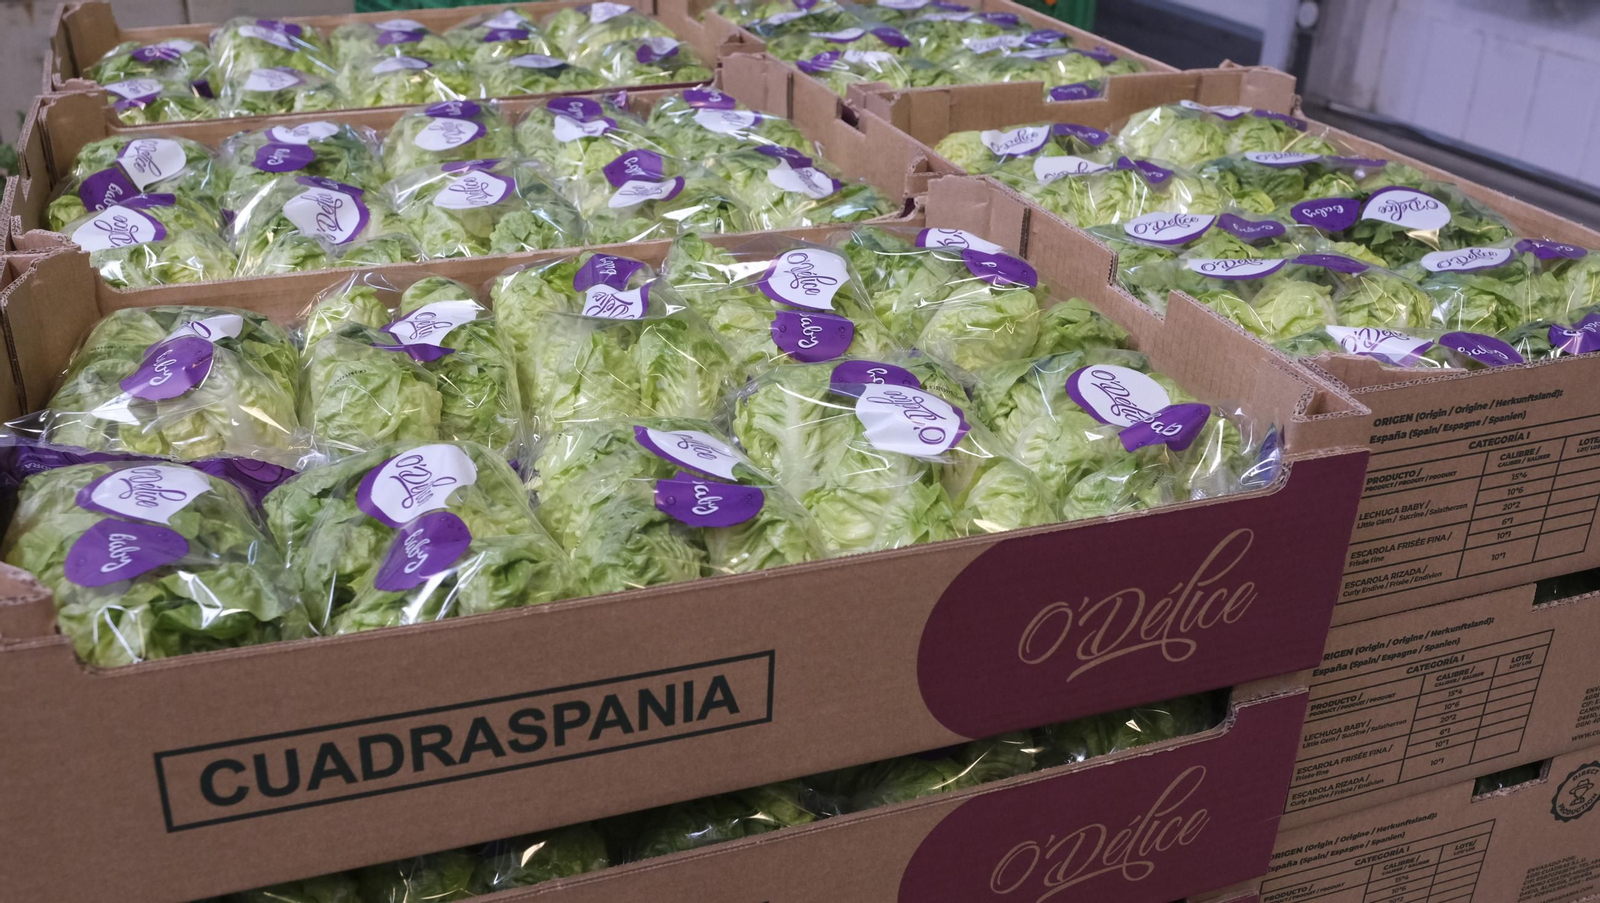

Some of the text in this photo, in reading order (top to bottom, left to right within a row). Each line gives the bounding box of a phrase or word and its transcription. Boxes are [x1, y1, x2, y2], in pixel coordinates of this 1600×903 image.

[1133, 213, 1200, 235] O'Délice
[798, 313, 824, 349] aby
[1373, 412, 1414, 428] ORIGEN
[1415, 407, 1447, 423] (Origin
[1454, 401, 1489, 414] Origine
[1369, 430, 1407, 445] España
[1443, 418, 1482, 432] Espagne
[1488, 410, 1528, 425] Spanien)
[1468, 432, 1525, 450] CATEGORÍA
[1578, 436, 1600, 446] LOTE
[1499, 448, 1536, 461] CALIBRE
[1366, 470, 1417, 486] PRODUCTO
[691, 480, 724, 516] aby
[1358, 502, 1426, 522] LECHUGA BABY
[1398, 510, 1425, 522] Sucrine
[1350, 534, 1447, 560] ESCAROLA FRISÉE FINA
[1344, 567, 1422, 590] ESCAROLA RIZADA
[1018, 527, 1259, 683] O'Délice
[1323, 647, 1354, 661] RIGEN
[1392, 633, 1424, 648] Origine
[1312, 662, 1348, 677] España
[1381, 647, 1418, 663] Espagne
[1406, 655, 1459, 674] CATEGORÍA
[1436, 668, 1471, 682] CALIBRE
[1310, 695, 1357, 712] PRODUCTO
[200, 674, 741, 806] CUADRASPANIA
[1303, 720, 1367, 742] LECHUGA BABY
[1297, 747, 1388, 775] ESCAROLA FRISÉE FINA
[1572, 768, 1599, 782] DIRECT
[1291, 776, 1365, 801] ESCAROLA RIZADA
[990, 765, 1211, 903] O'Délice
[1269, 860, 1298, 873] spaña
[1354, 848, 1404, 867] CATEGORÍA
[1263, 885, 1308, 902] PRODUCTO
